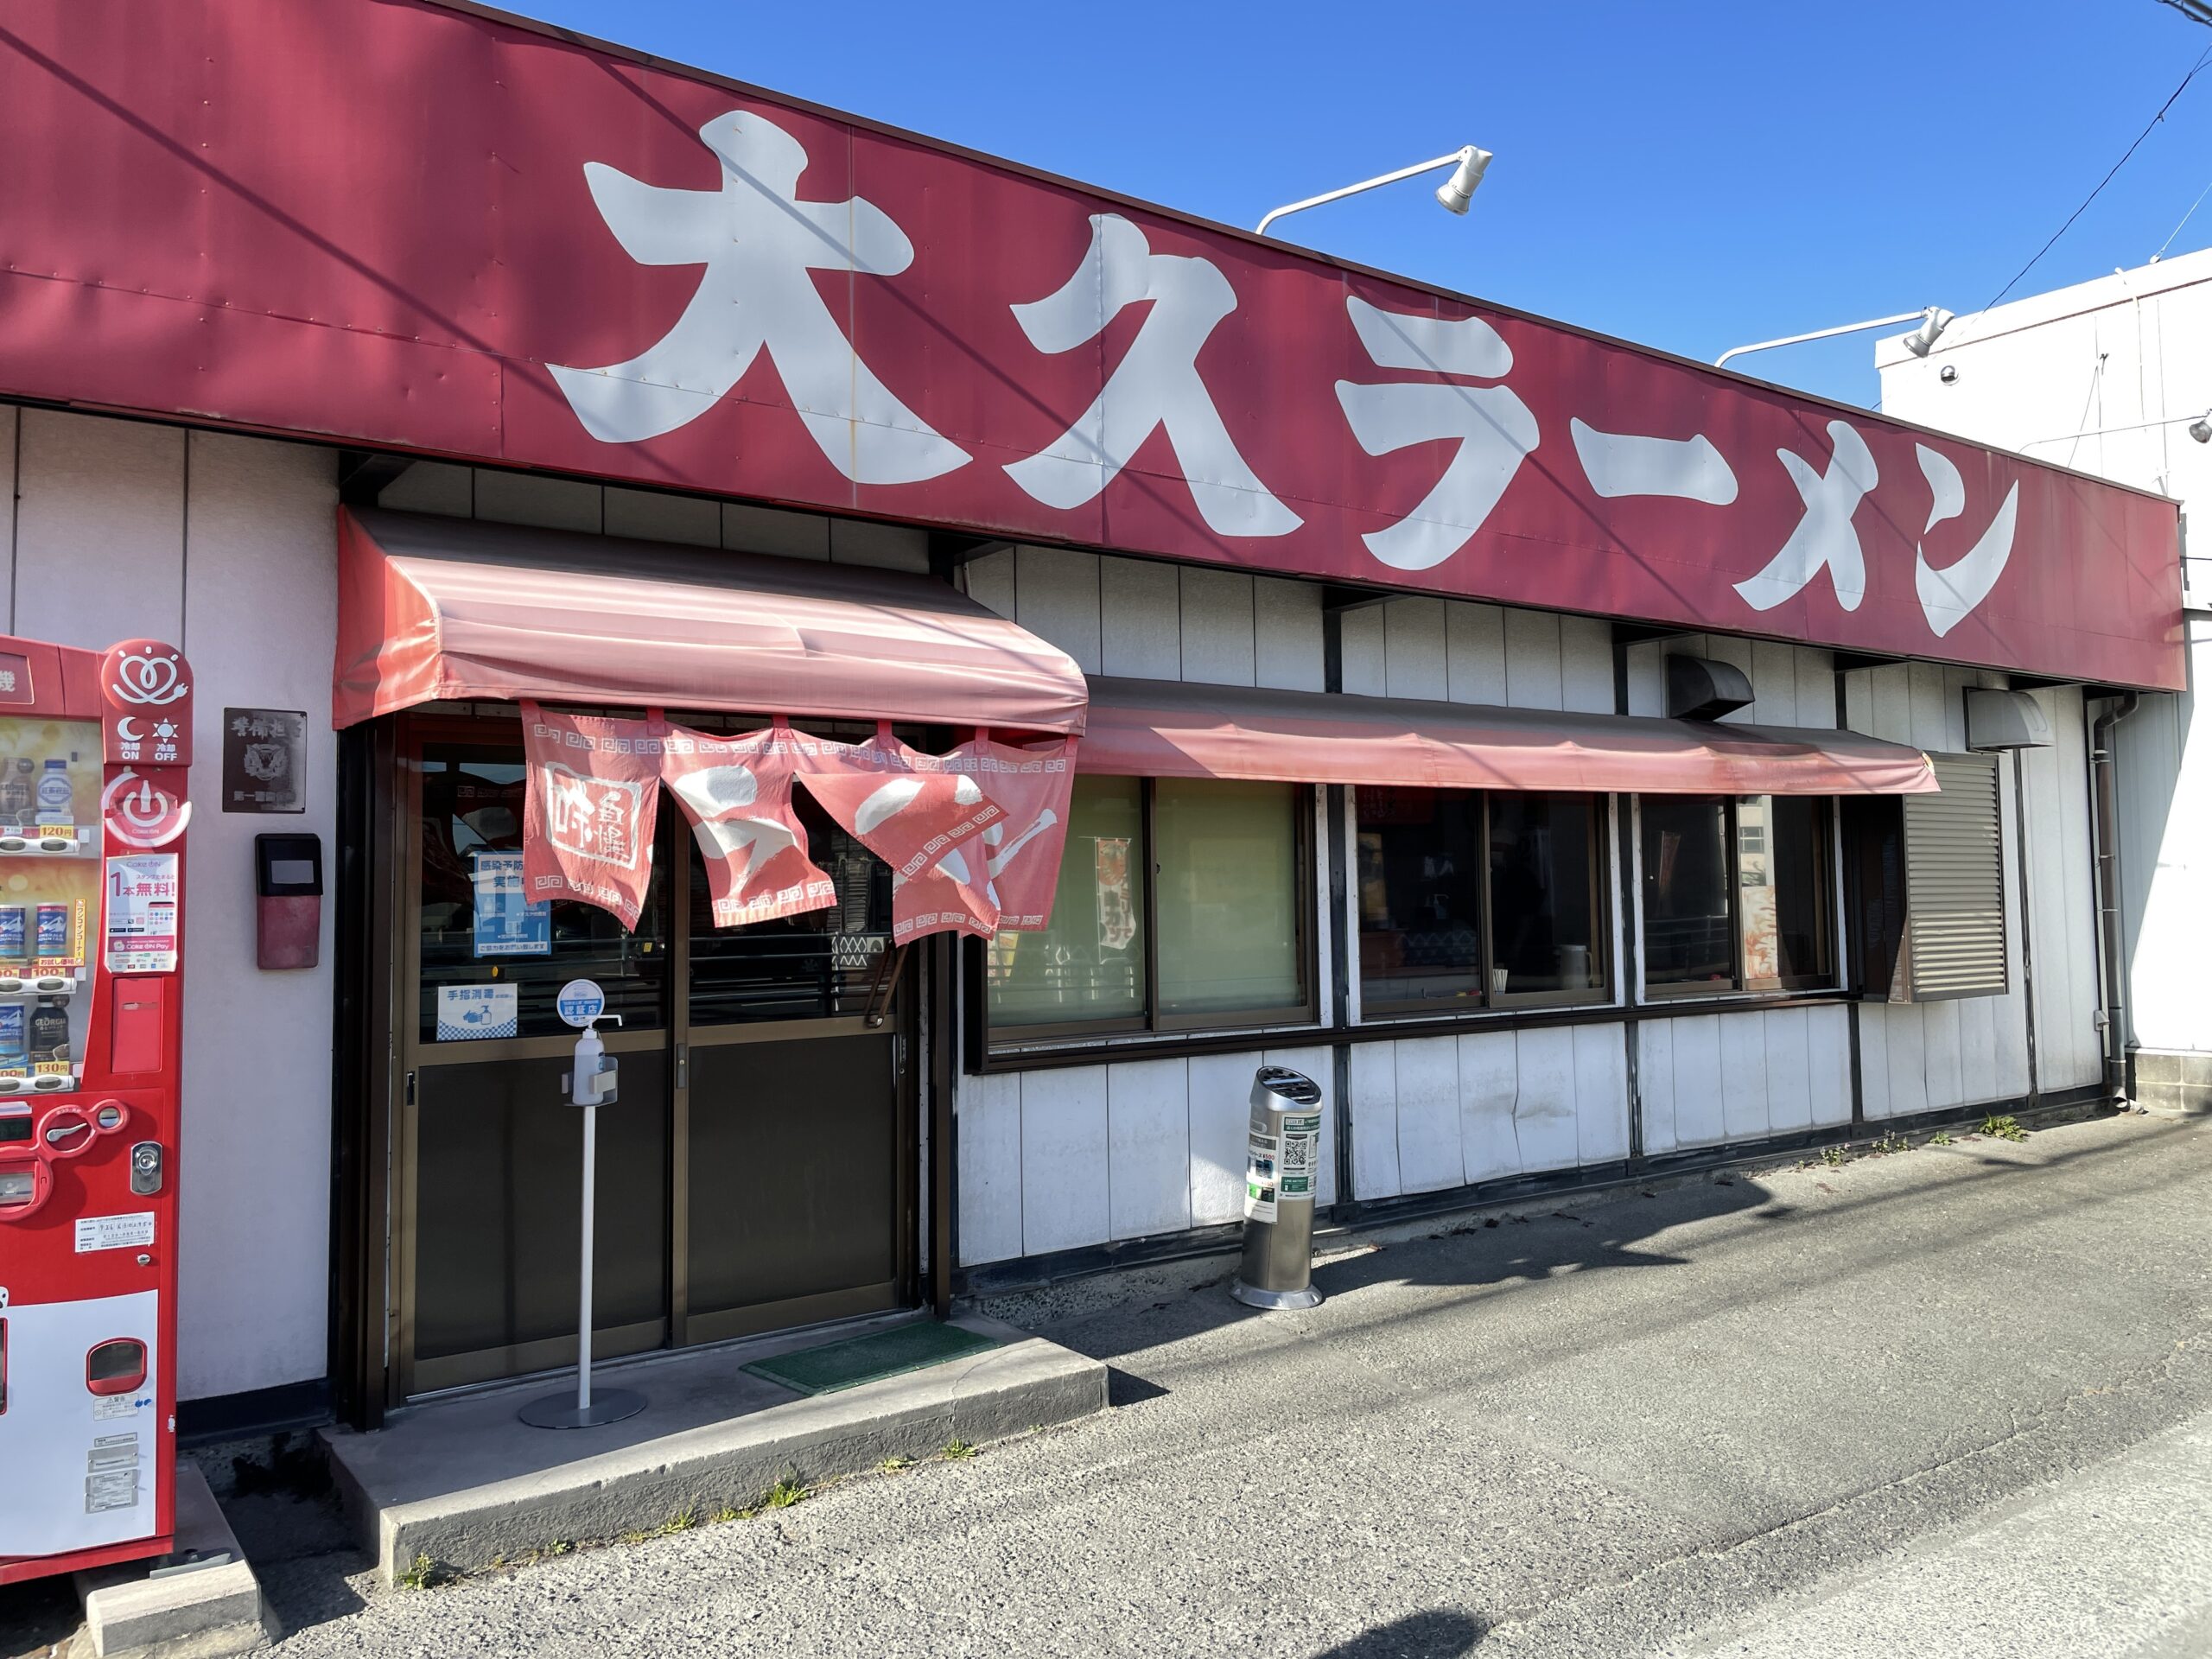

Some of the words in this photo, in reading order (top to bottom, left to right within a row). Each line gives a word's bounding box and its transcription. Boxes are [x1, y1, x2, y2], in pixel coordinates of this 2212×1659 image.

[545, 110, 2018, 638] 大久ラーメン
[231, 716, 302, 740] 警備担
[122, 752, 139, 760] ON
[155, 753, 177, 761] OFF
[41, 827, 72, 836] 120円
[494, 875, 524, 887] 実施
[447, 988, 494, 1001] 手指消毒
[36, 1063, 68, 1073] 130円
